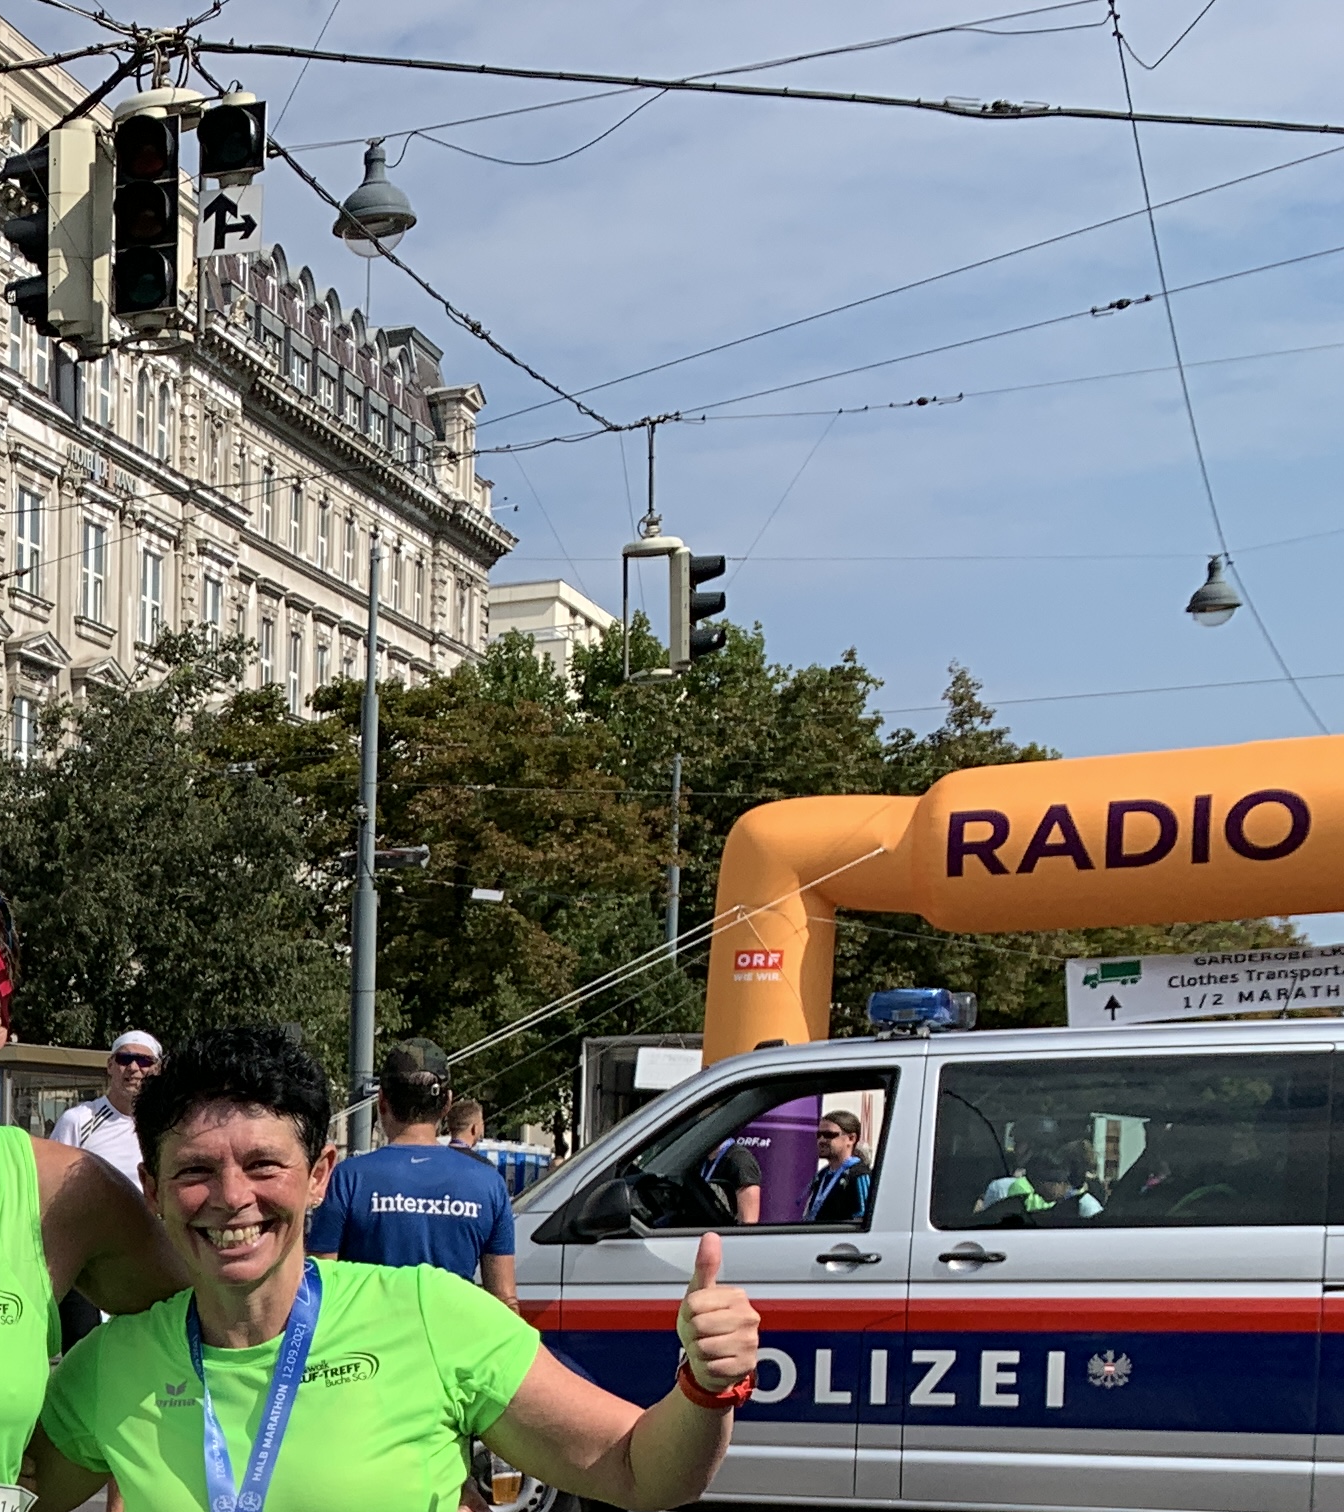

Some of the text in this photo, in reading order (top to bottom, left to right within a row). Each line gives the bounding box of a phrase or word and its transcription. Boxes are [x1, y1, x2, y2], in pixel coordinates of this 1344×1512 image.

[945, 788, 1311, 878] RADIO
[737, 953, 781, 967] ORF
[1193, 951, 1312, 966] GARDEROBE
[1168, 973, 1239, 988] Clothes
[371, 1192, 480, 1218] interxion
[0, 1315, 14, 1325] SG
[325, 1372, 367, 1388] Buchs SG
[678, 1347, 1066, 1408] OLIZEI
[252, 1323, 307, 1481] HALB MARATHON 12.09.2021
